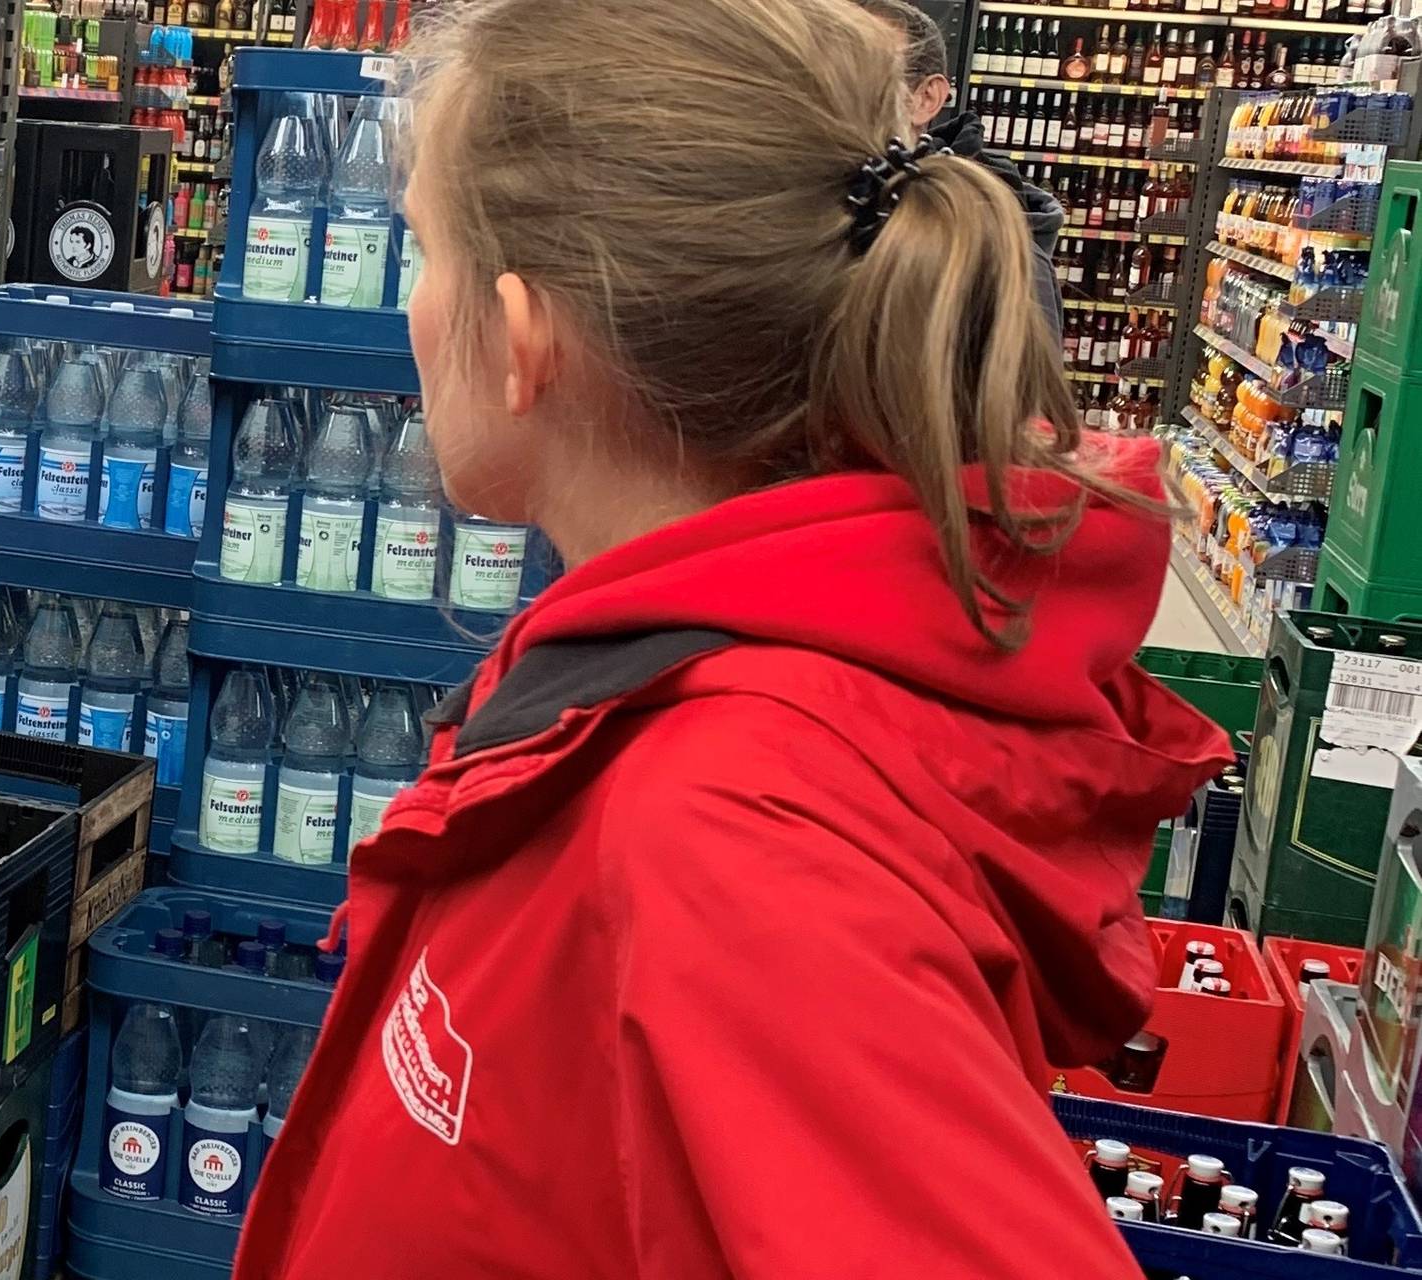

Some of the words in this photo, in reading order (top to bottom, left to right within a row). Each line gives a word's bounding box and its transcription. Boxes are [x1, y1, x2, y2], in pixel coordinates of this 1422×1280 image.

[1344, 655, 1382, 669] 73117
[206, 1172, 232, 1181] QUELLE
[114, 1178, 147, 1190] CLASSIC
[194, 1195, 228, 1208] CLASSIC
